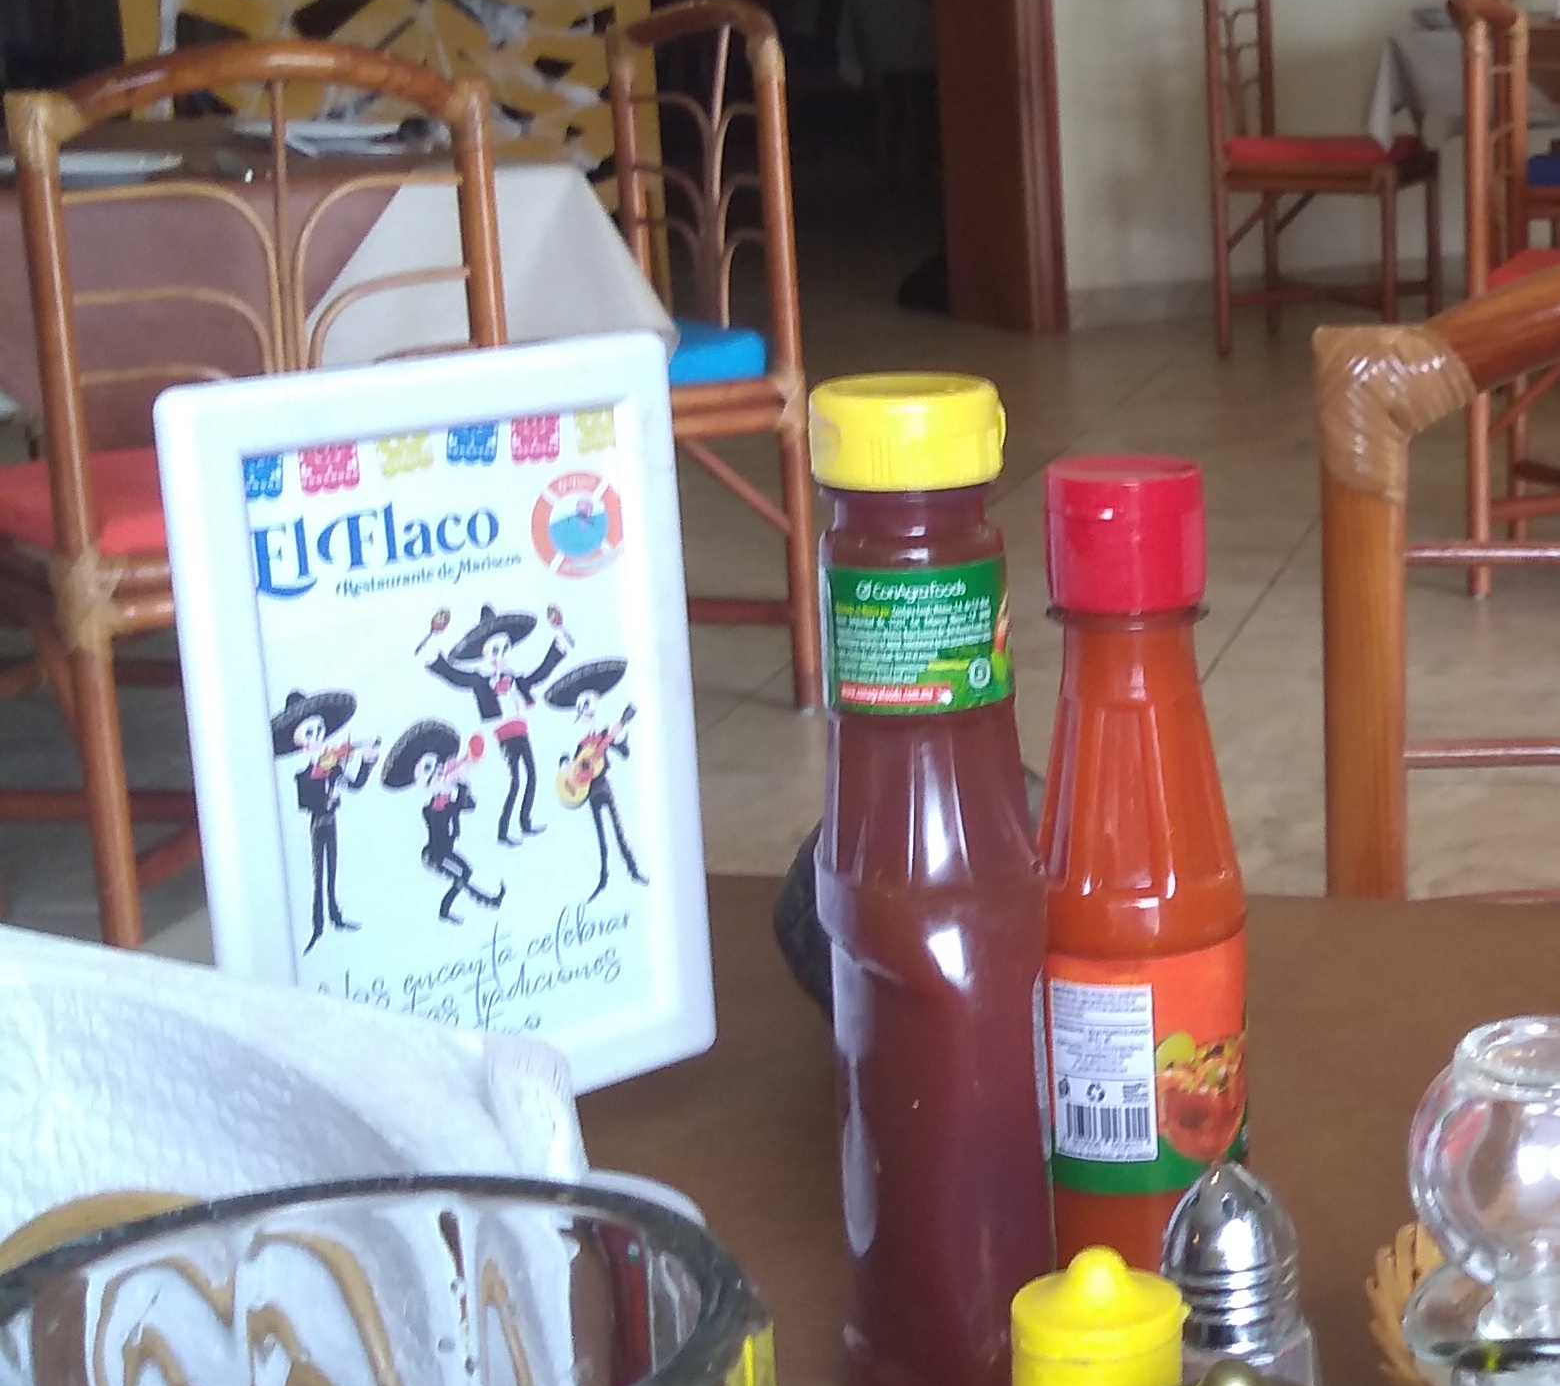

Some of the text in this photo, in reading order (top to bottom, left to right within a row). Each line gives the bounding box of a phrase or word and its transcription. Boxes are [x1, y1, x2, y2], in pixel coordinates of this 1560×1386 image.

[250, 500, 500, 600] El Flaco
[526, 901, 631, 968] celebrar
